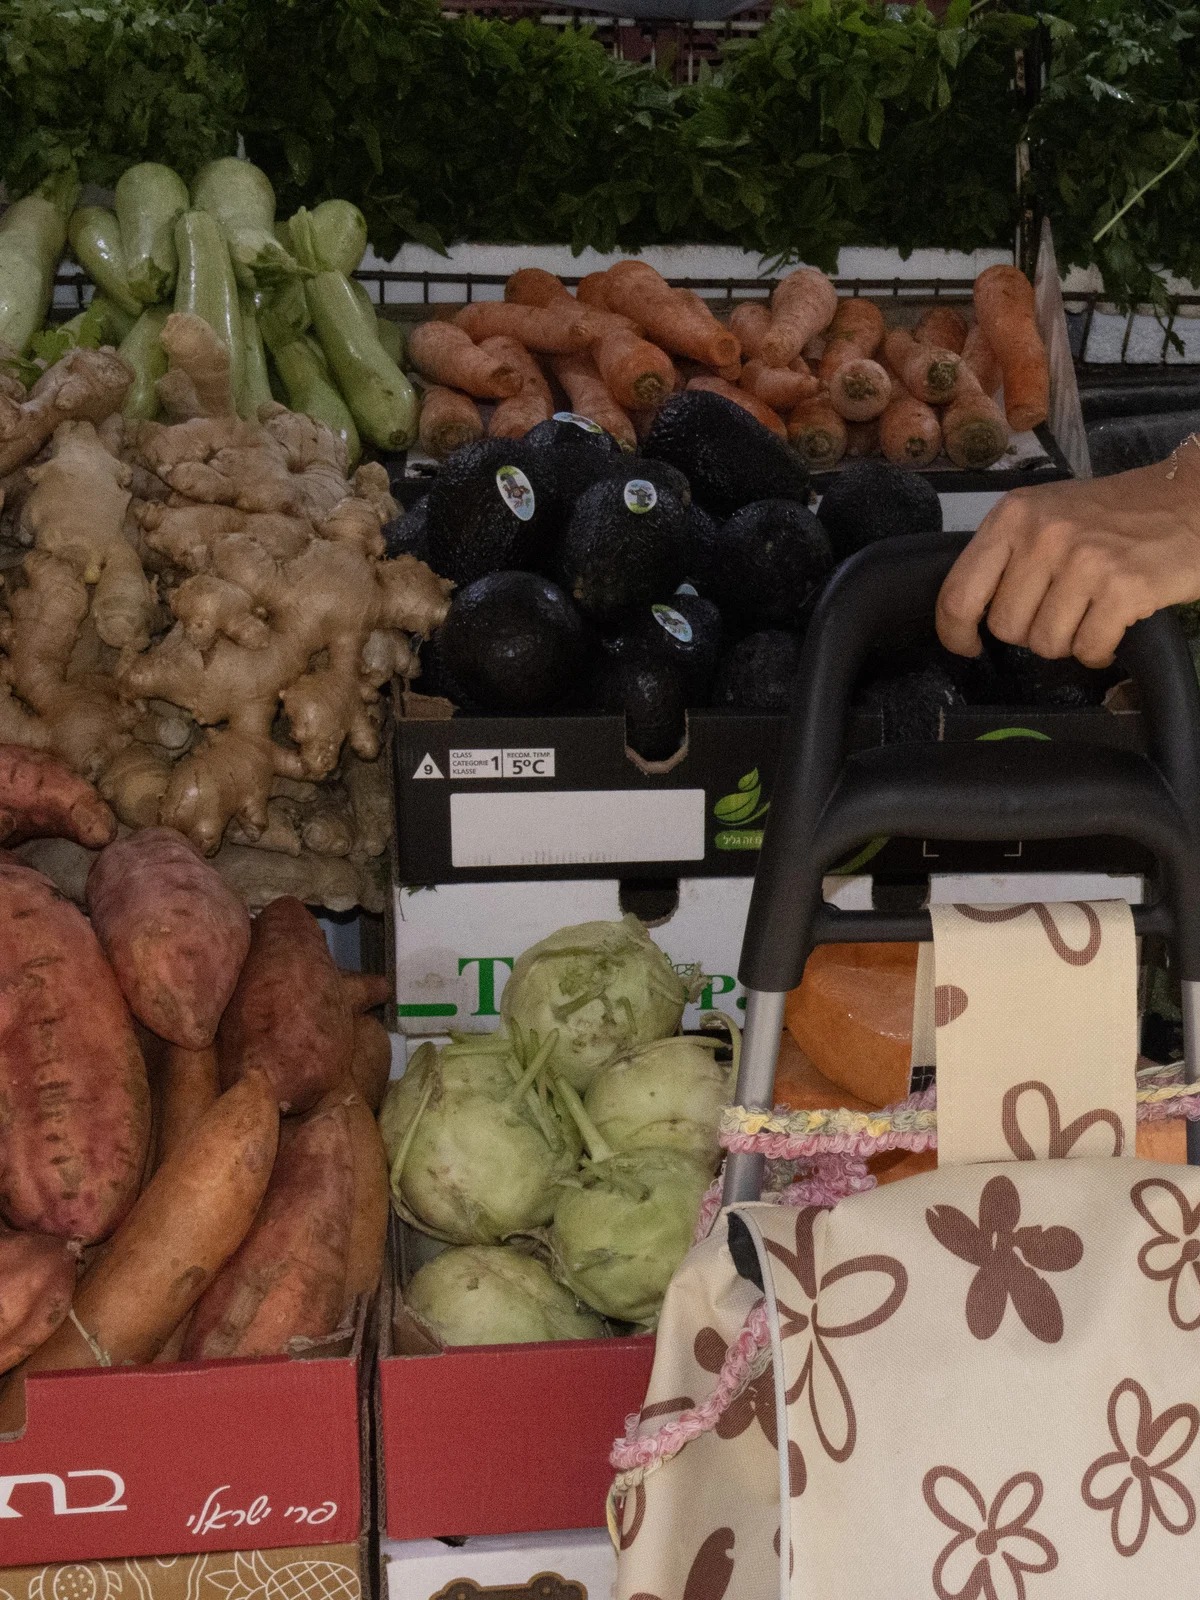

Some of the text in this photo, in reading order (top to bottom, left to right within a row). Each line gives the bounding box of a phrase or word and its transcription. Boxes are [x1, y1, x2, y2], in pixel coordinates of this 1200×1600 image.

[424, 764, 433, 775] 9
[452, 759, 489, 767] CATEGORIE
[491, 756, 499, 771] 1
[186, 1485, 338, 1535] פרי ישראלי
